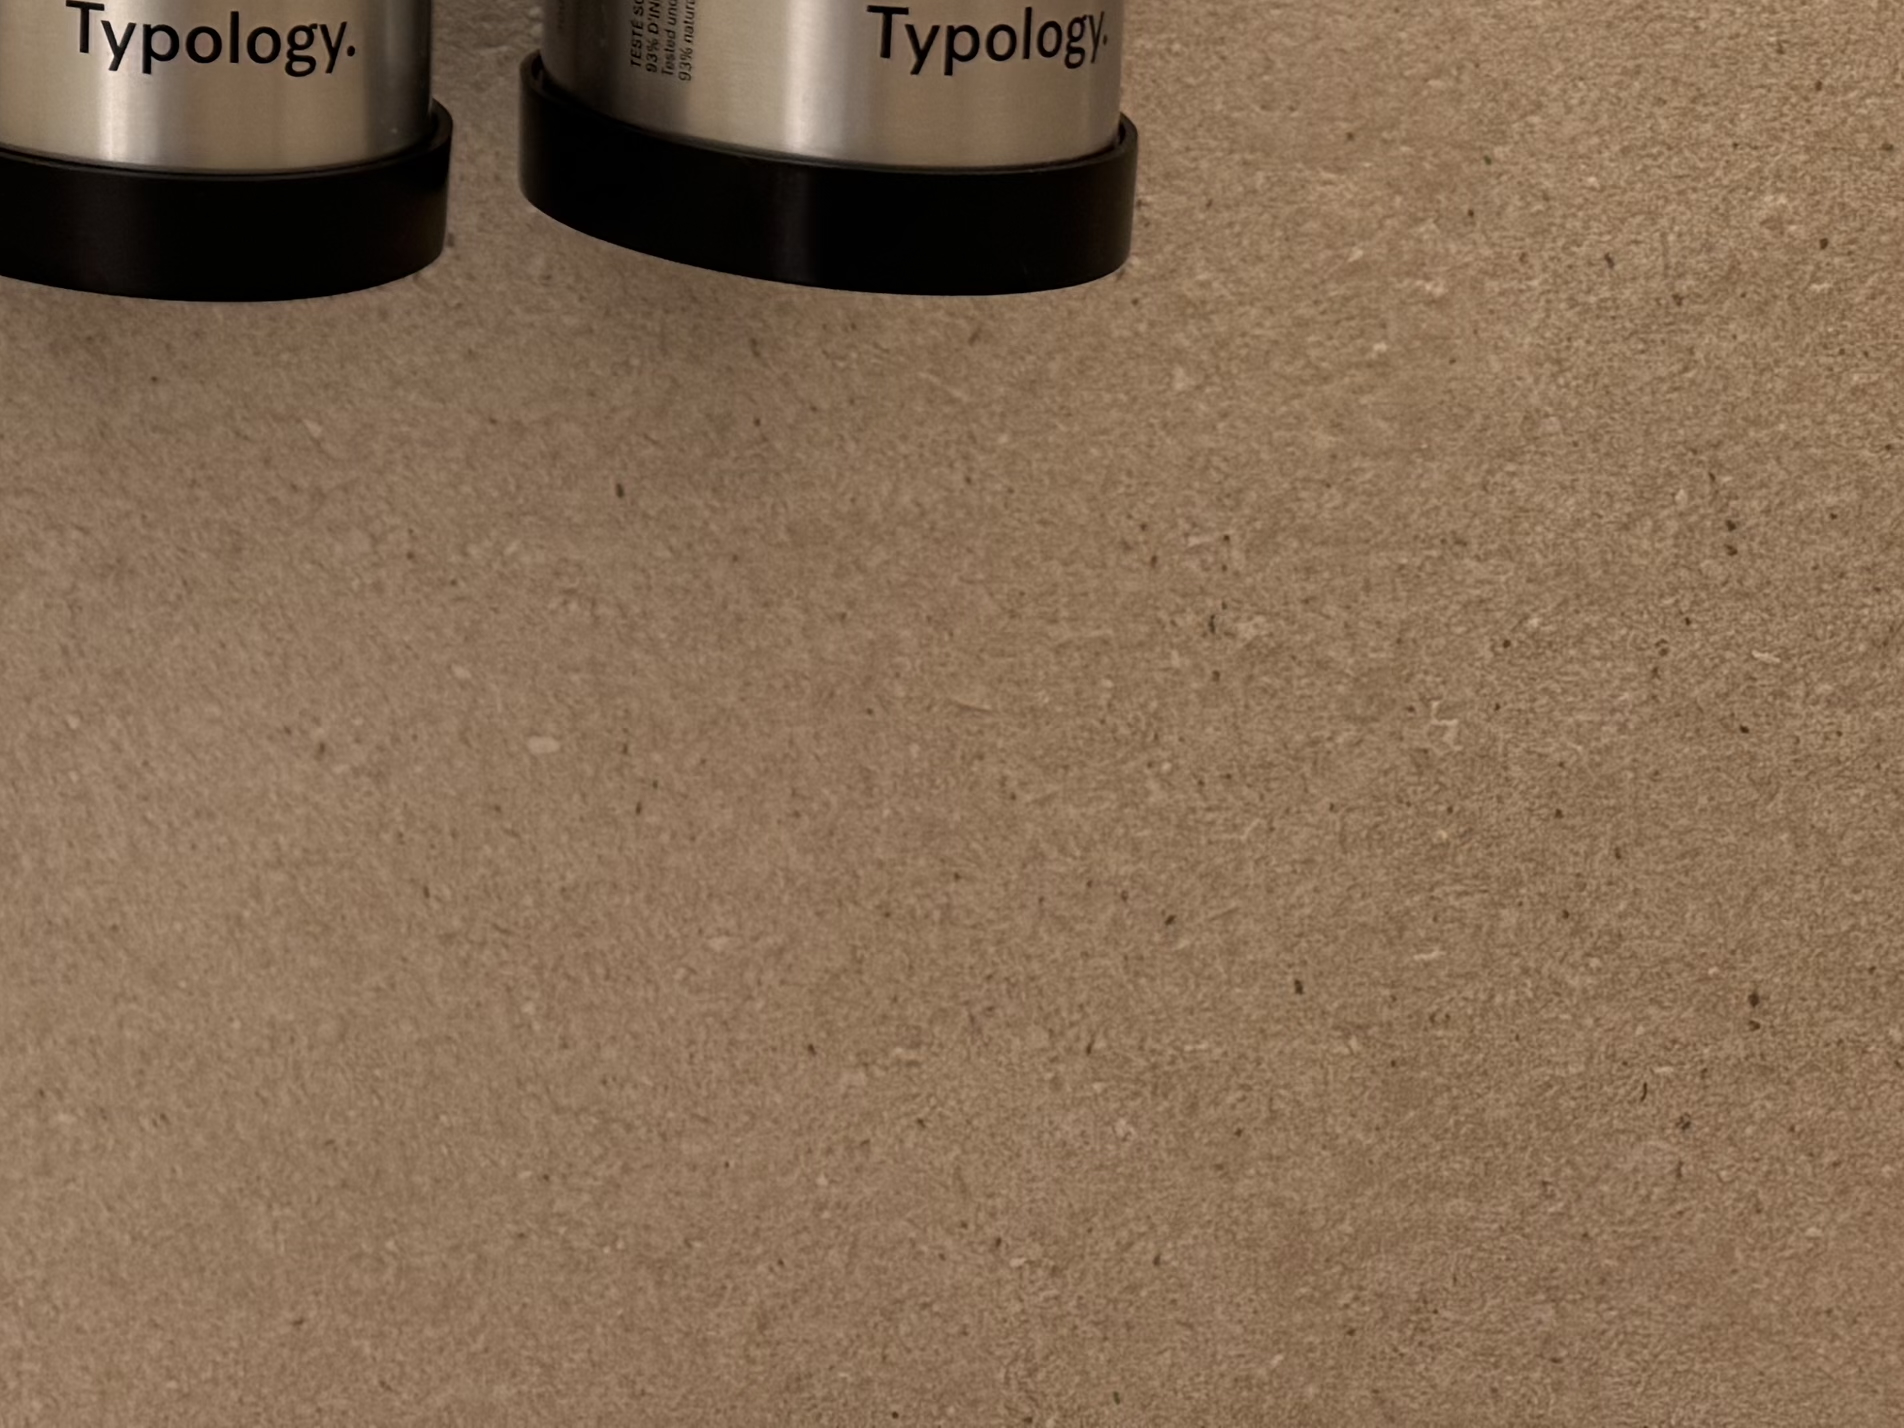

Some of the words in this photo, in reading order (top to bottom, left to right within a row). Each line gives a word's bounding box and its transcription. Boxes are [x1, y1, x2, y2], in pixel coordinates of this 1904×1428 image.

[65, 0, 356, 78] Typology.
[630, 18, 644, 67] TESTÉ
[646, 38, 659, 73] 93%
[661, 29, 677, 76] Tested
[867, 5, 1109, 76] Typology.
[678, 47, 693, 82] 93%
